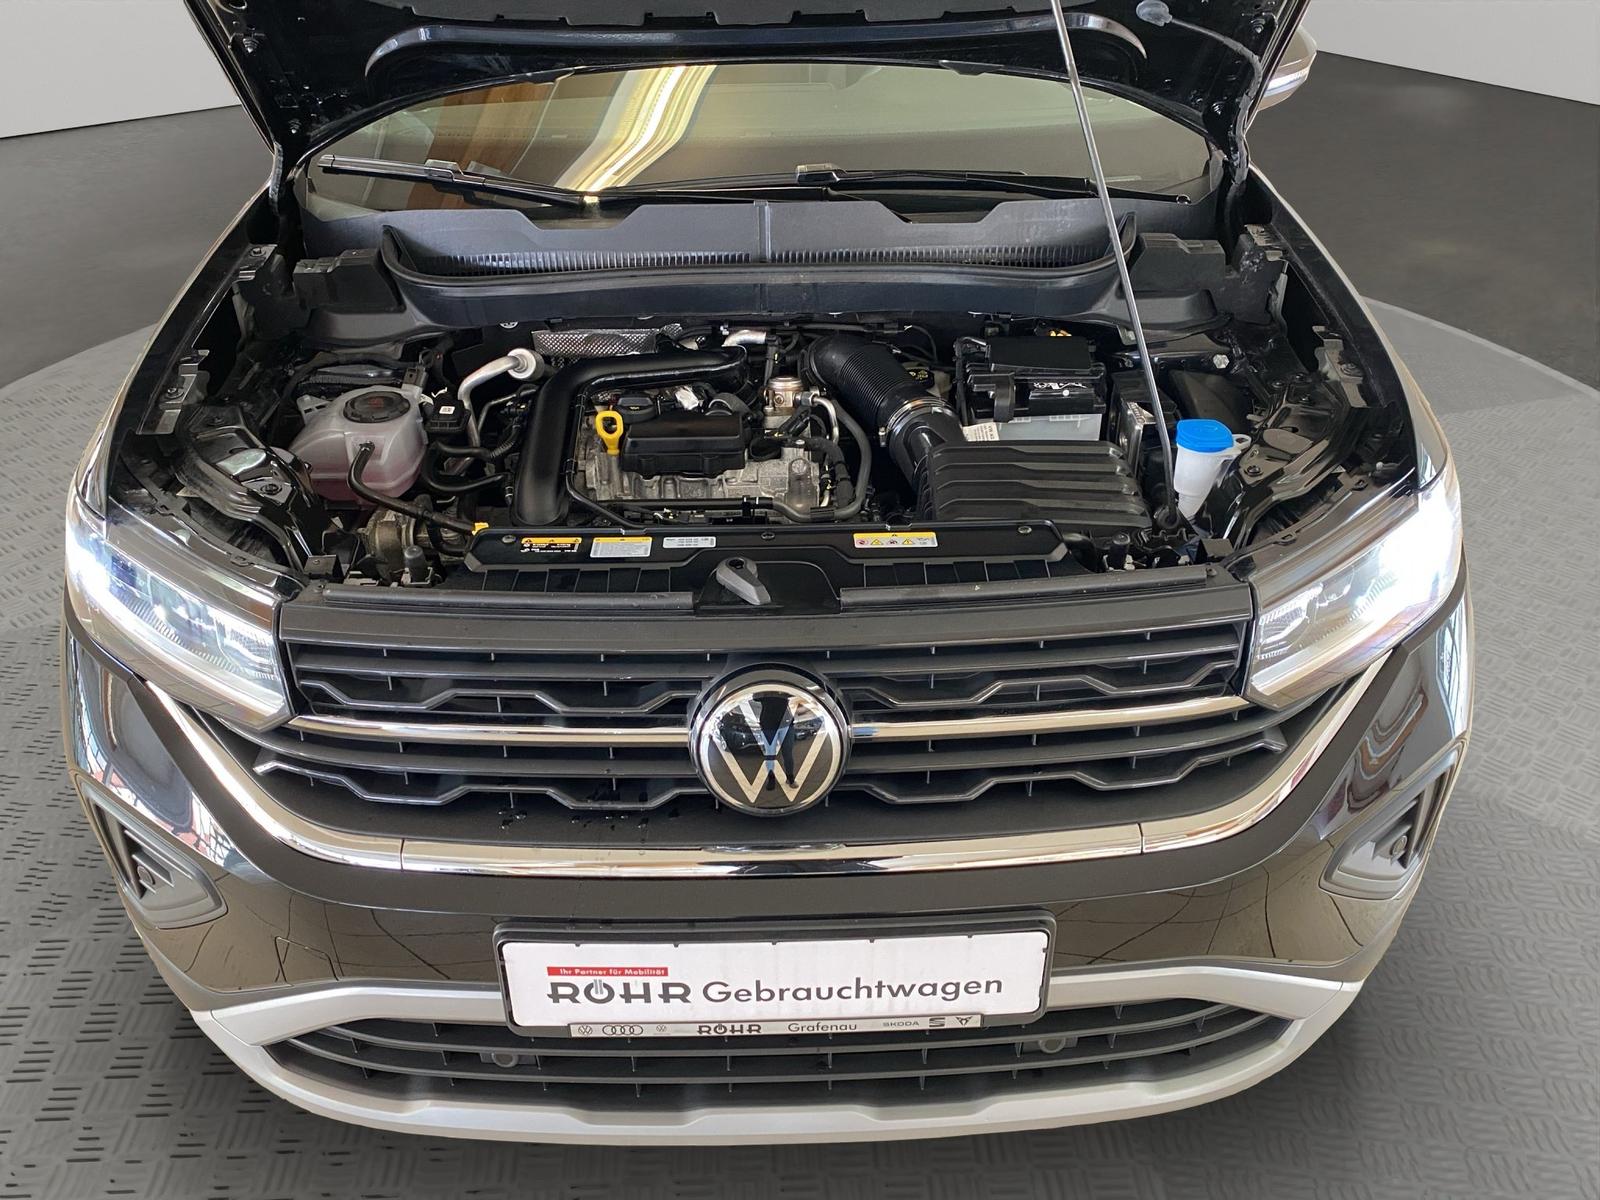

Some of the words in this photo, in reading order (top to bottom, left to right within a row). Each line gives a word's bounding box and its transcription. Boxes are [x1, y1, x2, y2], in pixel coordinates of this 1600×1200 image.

[546, 979, 692, 1004] RÖHR
[702, 977, 1003, 1003] Gebrauchtwagen
[787, 1022, 857, 1033] Grafenau
